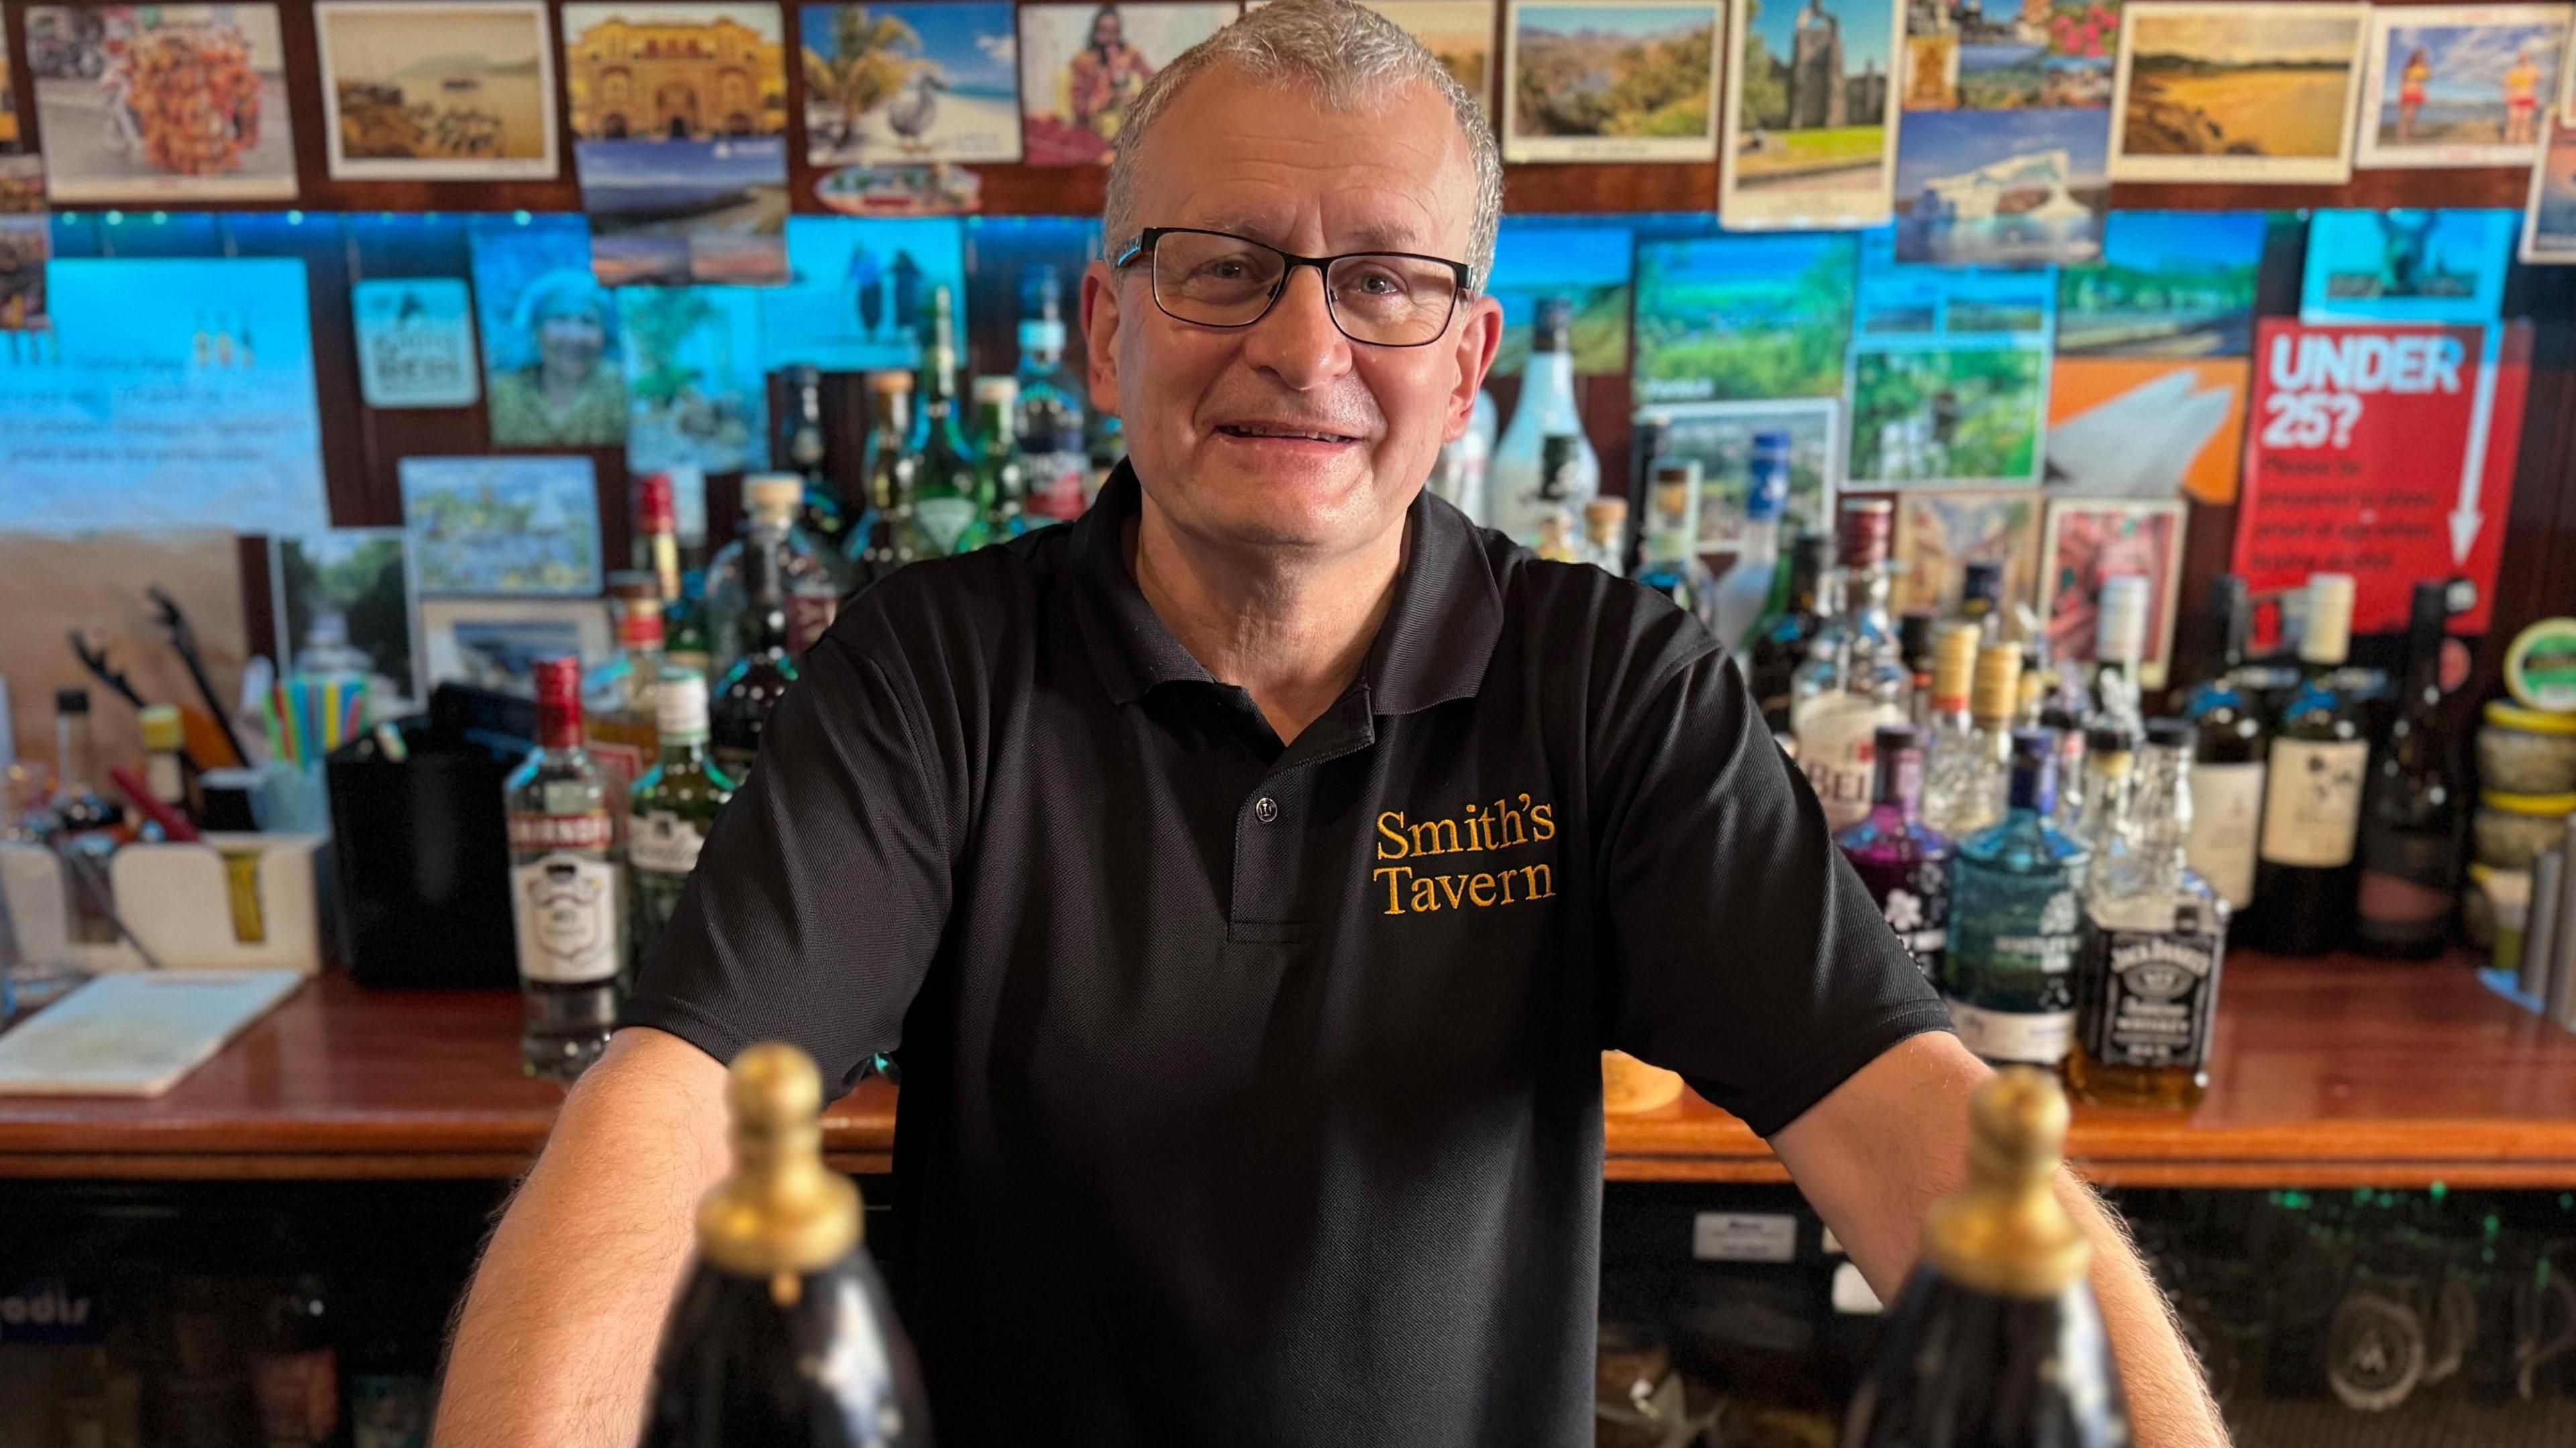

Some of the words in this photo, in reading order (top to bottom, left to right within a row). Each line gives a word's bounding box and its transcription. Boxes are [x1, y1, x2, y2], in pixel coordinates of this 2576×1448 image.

[2271, 335, 2465, 393] UNDER
[2260, 391, 2363, 448] 25?
[1377, 793, 1556, 860] Smith's
[1373, 864, 1556, 914] Tavern
